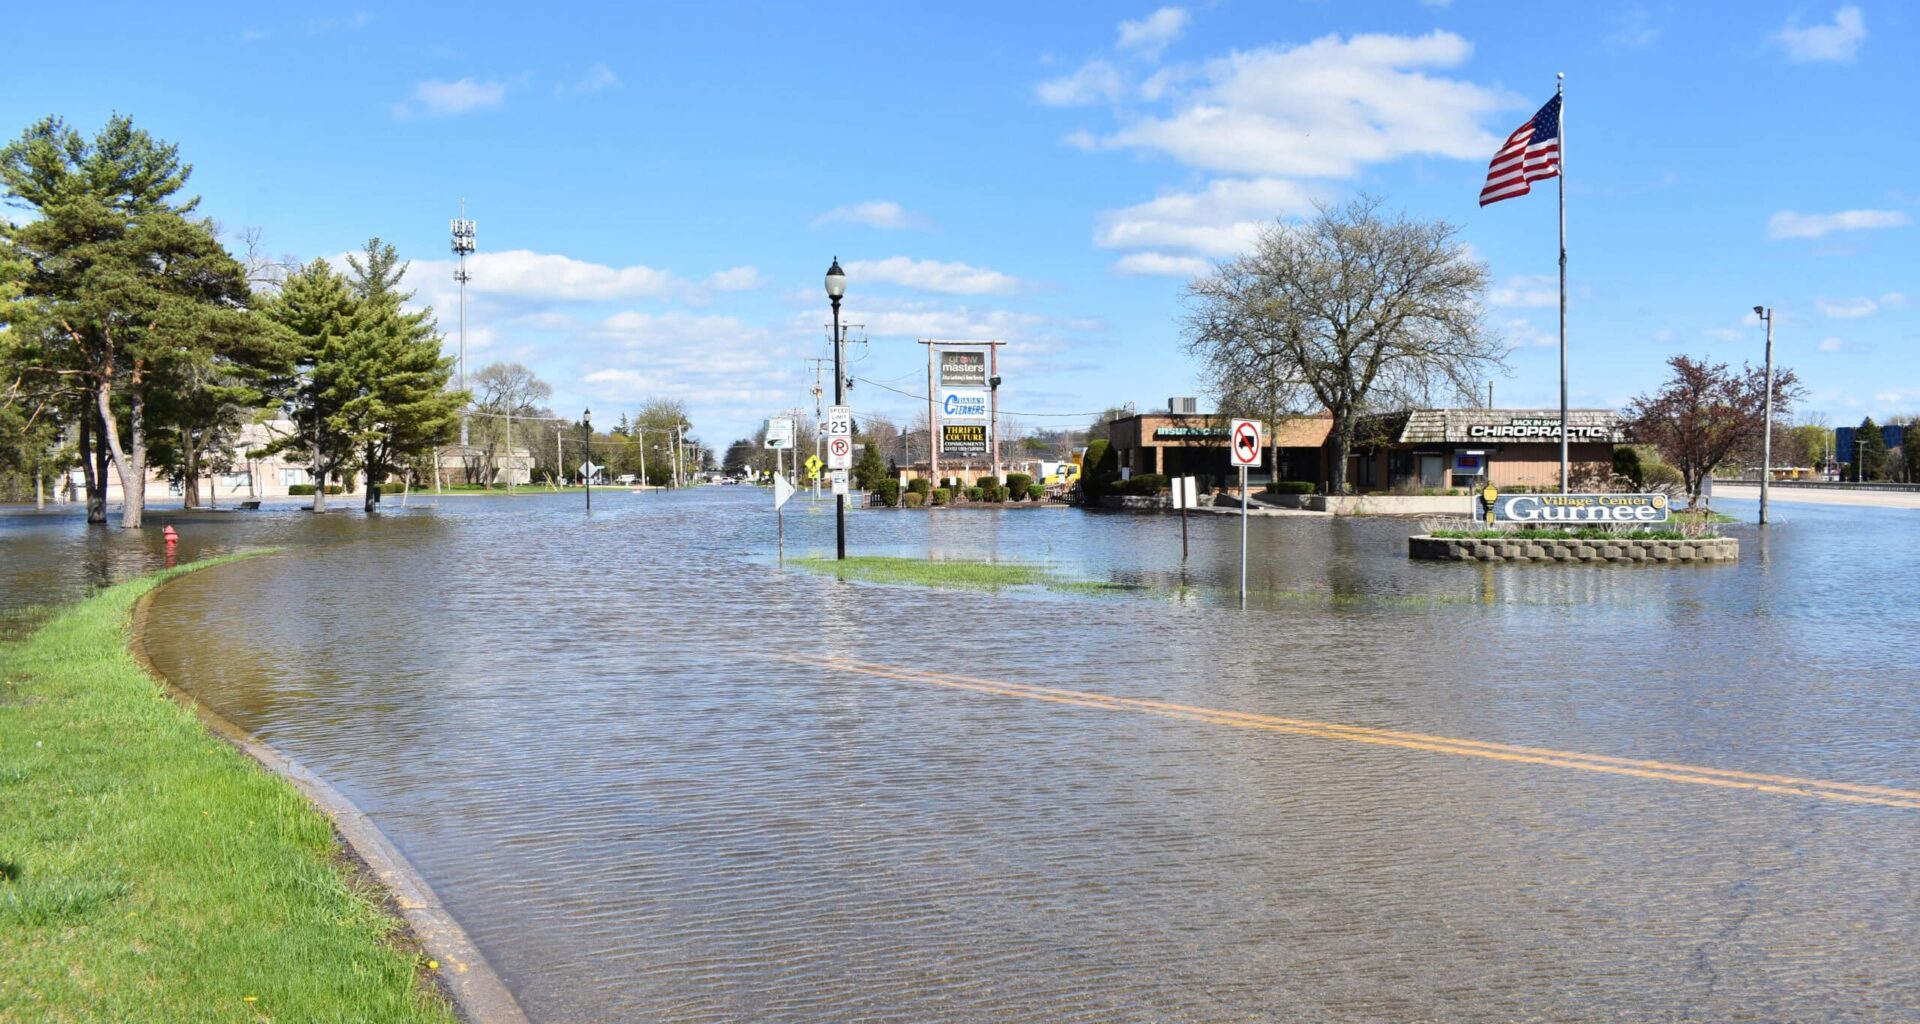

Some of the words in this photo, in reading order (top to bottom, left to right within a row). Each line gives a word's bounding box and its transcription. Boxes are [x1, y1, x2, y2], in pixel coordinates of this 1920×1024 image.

[943, 364, 984, 372] masters
[831, 421, 848, 434] 25
[947, 426, 982, 434] THRIFTY
[1471, 425, 1604, 437] CHIROPRACTIC
[1541, 496, 1593, 507] Village
[1599, 496, 1648, 506] Center
[1505, 497, 1657, 521] Gurnee
